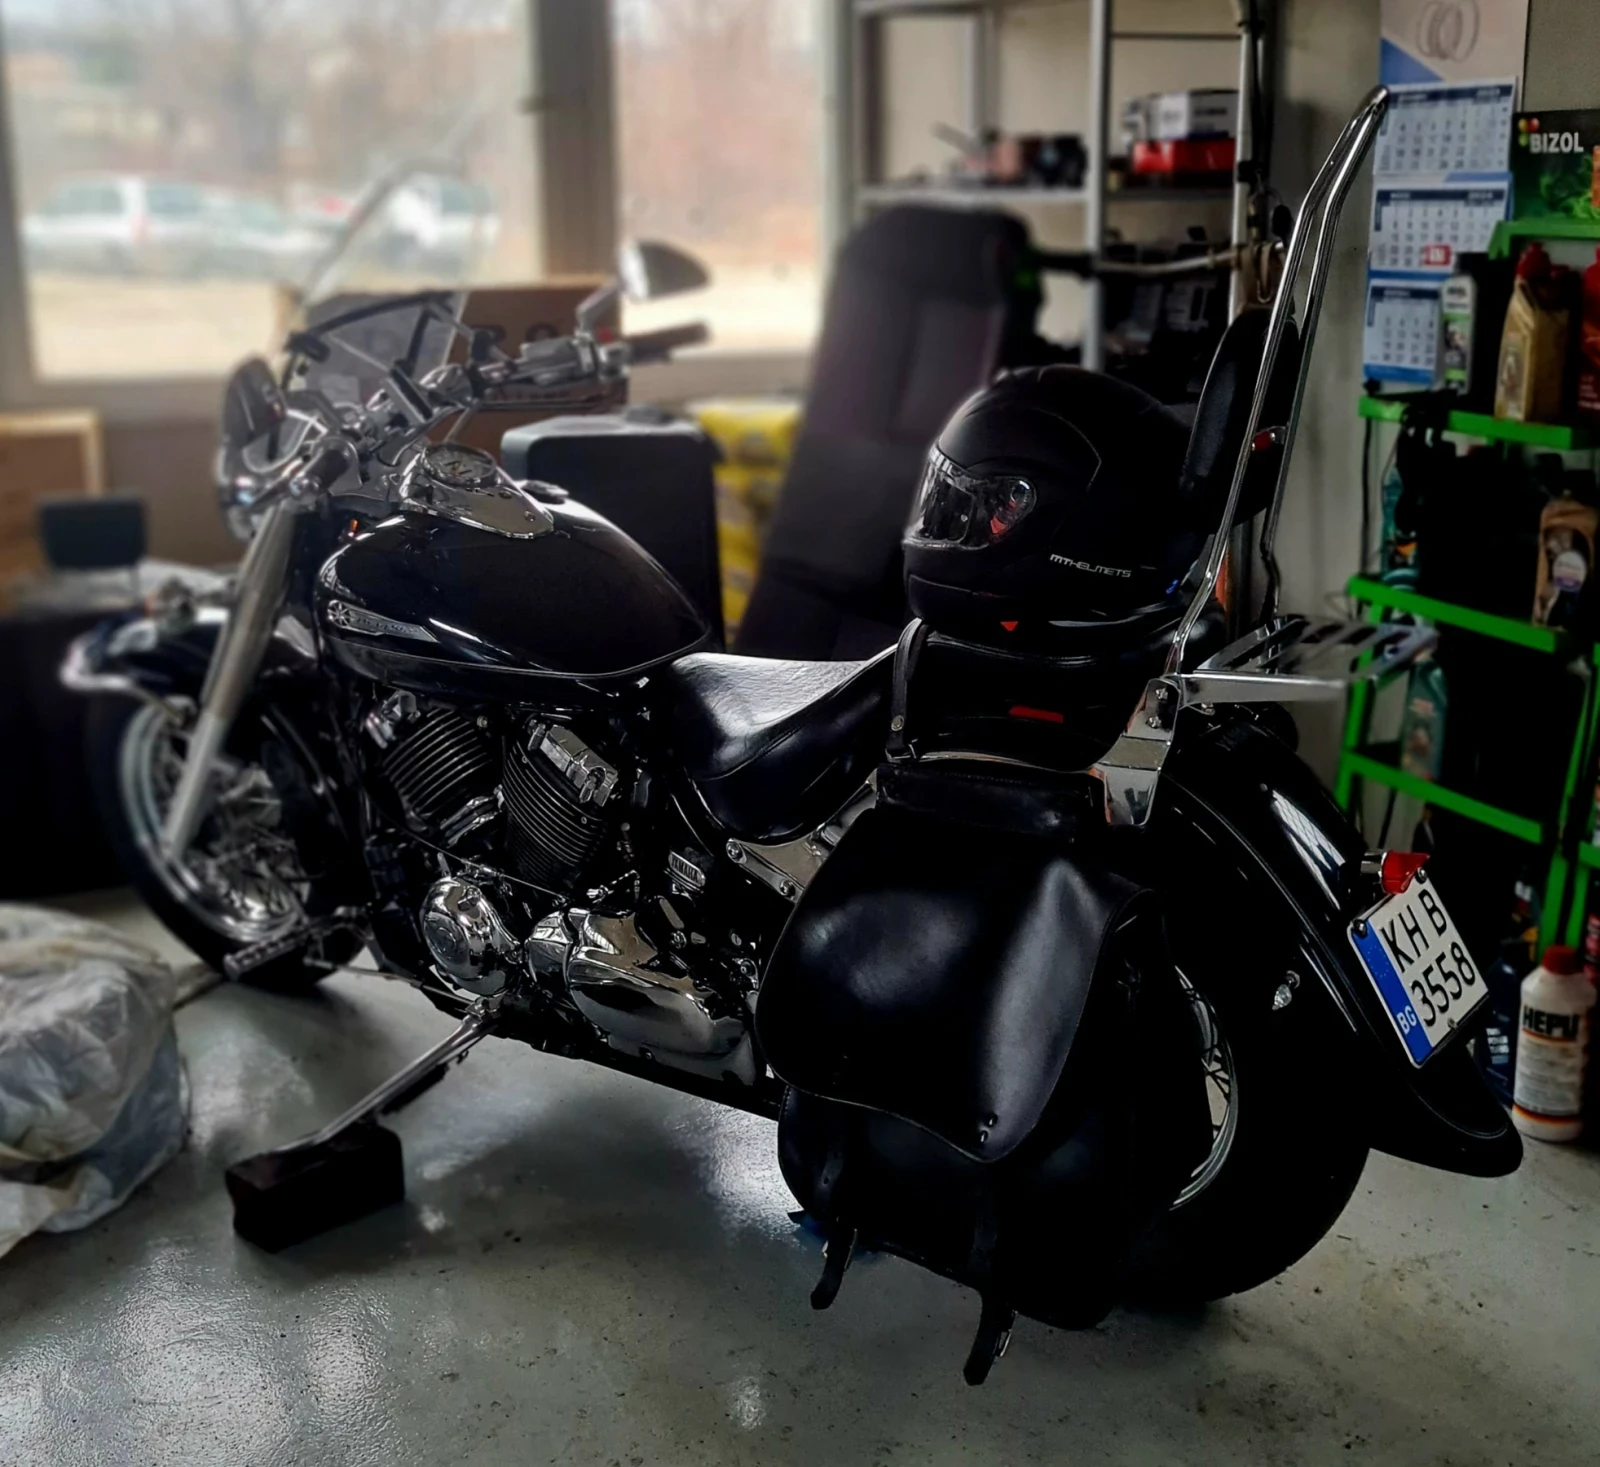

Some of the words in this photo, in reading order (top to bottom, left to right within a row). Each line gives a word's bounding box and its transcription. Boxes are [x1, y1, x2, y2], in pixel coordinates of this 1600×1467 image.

[1529, 131, 1585, 154] BIZOL
[1379, 904, 1430, 973] KH
[1417, 888, 1447, 937] B
[1410, 941, 1476, 1027] 3558
[1396, 1004, 1418, 1036] BG
[1523, 1005, 1580, 1042] HEPU
